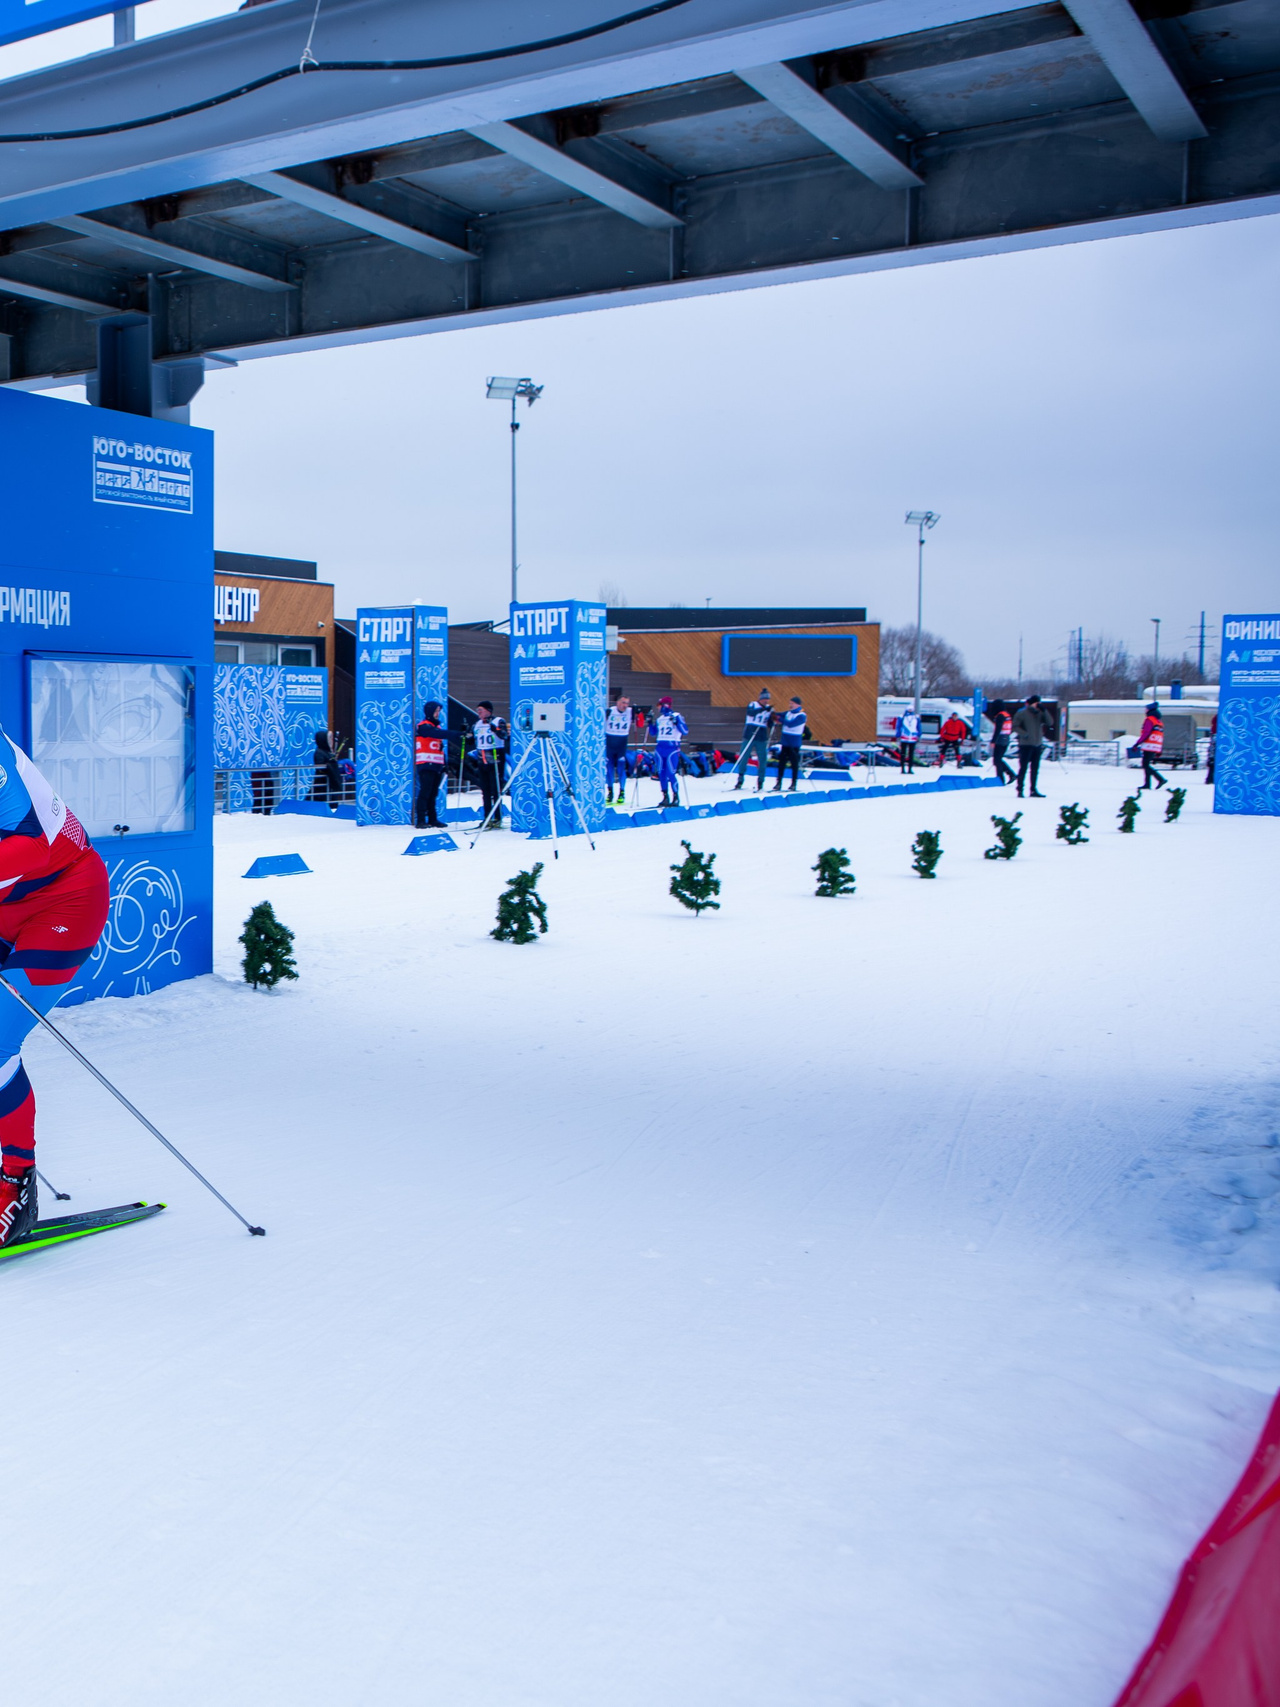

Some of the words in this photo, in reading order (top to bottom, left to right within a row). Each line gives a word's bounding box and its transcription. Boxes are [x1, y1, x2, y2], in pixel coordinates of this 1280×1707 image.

[92, 435, 192, 469] ЮГО-ВОСТОК
[214, 585, 260, 625] ЦЕНТР
[359, 617, 412, 642] СТАРТ
[513, 607, 570, 637] СТАРТ
